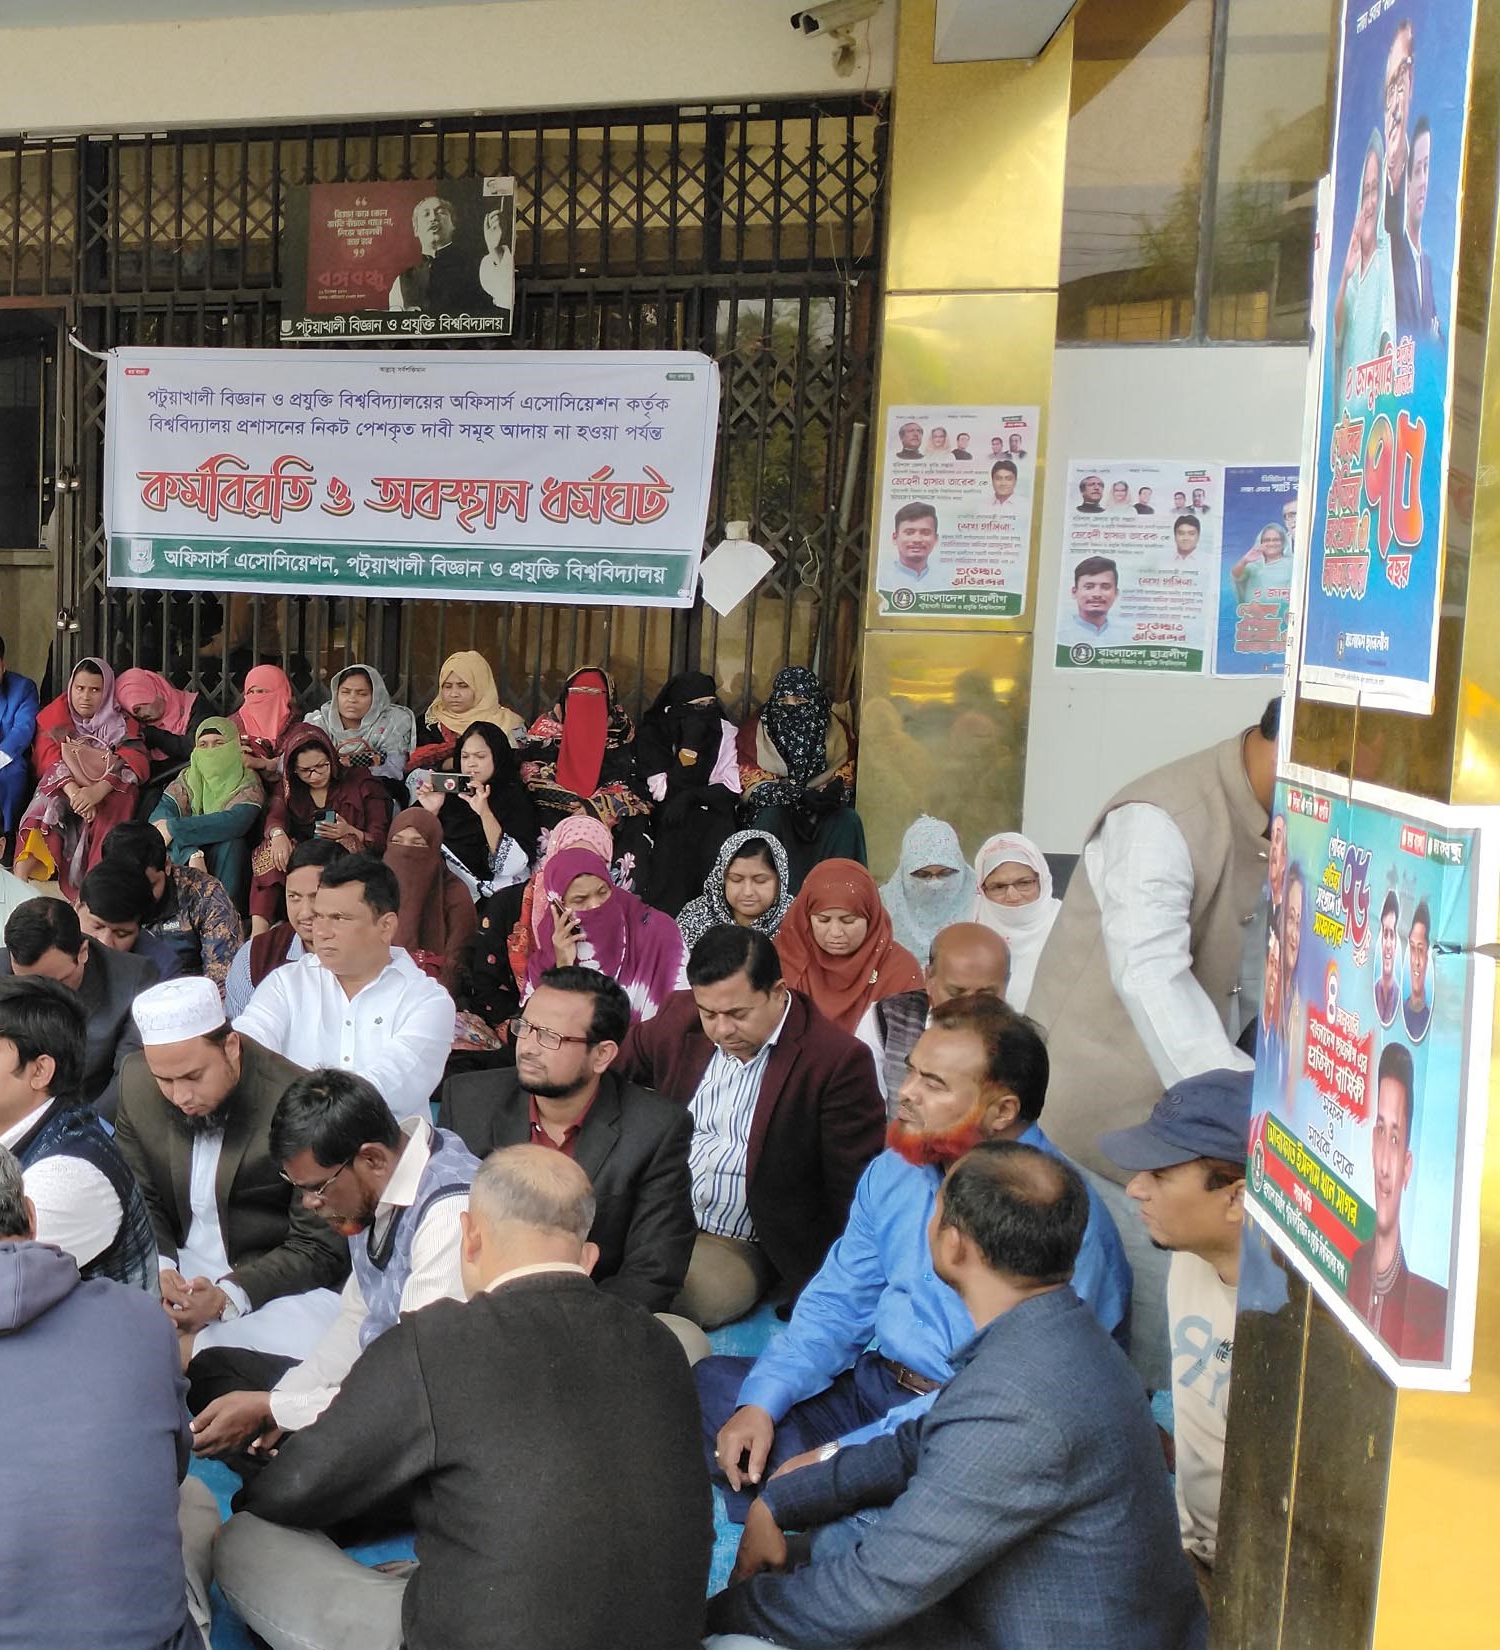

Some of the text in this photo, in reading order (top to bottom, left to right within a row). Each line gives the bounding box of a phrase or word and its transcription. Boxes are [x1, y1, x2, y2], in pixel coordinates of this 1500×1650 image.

[295, 313, 504, 338] পটুয়াখালী বিজ্ঞান ও প্রযুক্তি বিশ্ববিদ্যালয়
[1356, 342, 1394, 412] জানুয়ারি
[148, 387, 671, 419] পটুয়াখালী বিজ্ঞান ও প্রযুক্তি বিশ্ববিদ্যালয়ের অফিসার্স এসোসিয়েশন কর্তৃক
[149, 414, 664, 444] বিশ্ববিদ্যালয় প্রশাসনের নিকট পেশকৃত দাবী সমূহ আদায় না হওয়া পর্যন্ত
[136, 453, 674, 534] কর্মবিরতি ও অবস্থান ধর্মঘট
[1364, 409, 1427, 560] ৭৫
[164, 546, 668, 585] অফিসার্স এসোসিয়েশন, পটুয়াখালী বিজ্ঞান ও প্রযুক্তি বিশ্ববিদ্যালয়
[1386, 554, 1412, 589] বছর
[918, 592, 1007, 605] বাংলাদেশ ছাত্রলীগ
[1326, 974, 1338, 1025] ৪
[1310, 1018, 1368, 1075] বাংলাদেশ ছাত্রলীগ এর
[1307, 1044, 1366, 1106] প্রতিষ্ঠা বার্ষিকী
[1322, 1094, 1345, 1128] সফল
[1327, 1122, 1334, 1141] ও
[1308, 1124, 1355, 1179] সার্থক হোক
[1267, 1120, 1359, 1229] আরাফাত ইসলাম খান সাগর
